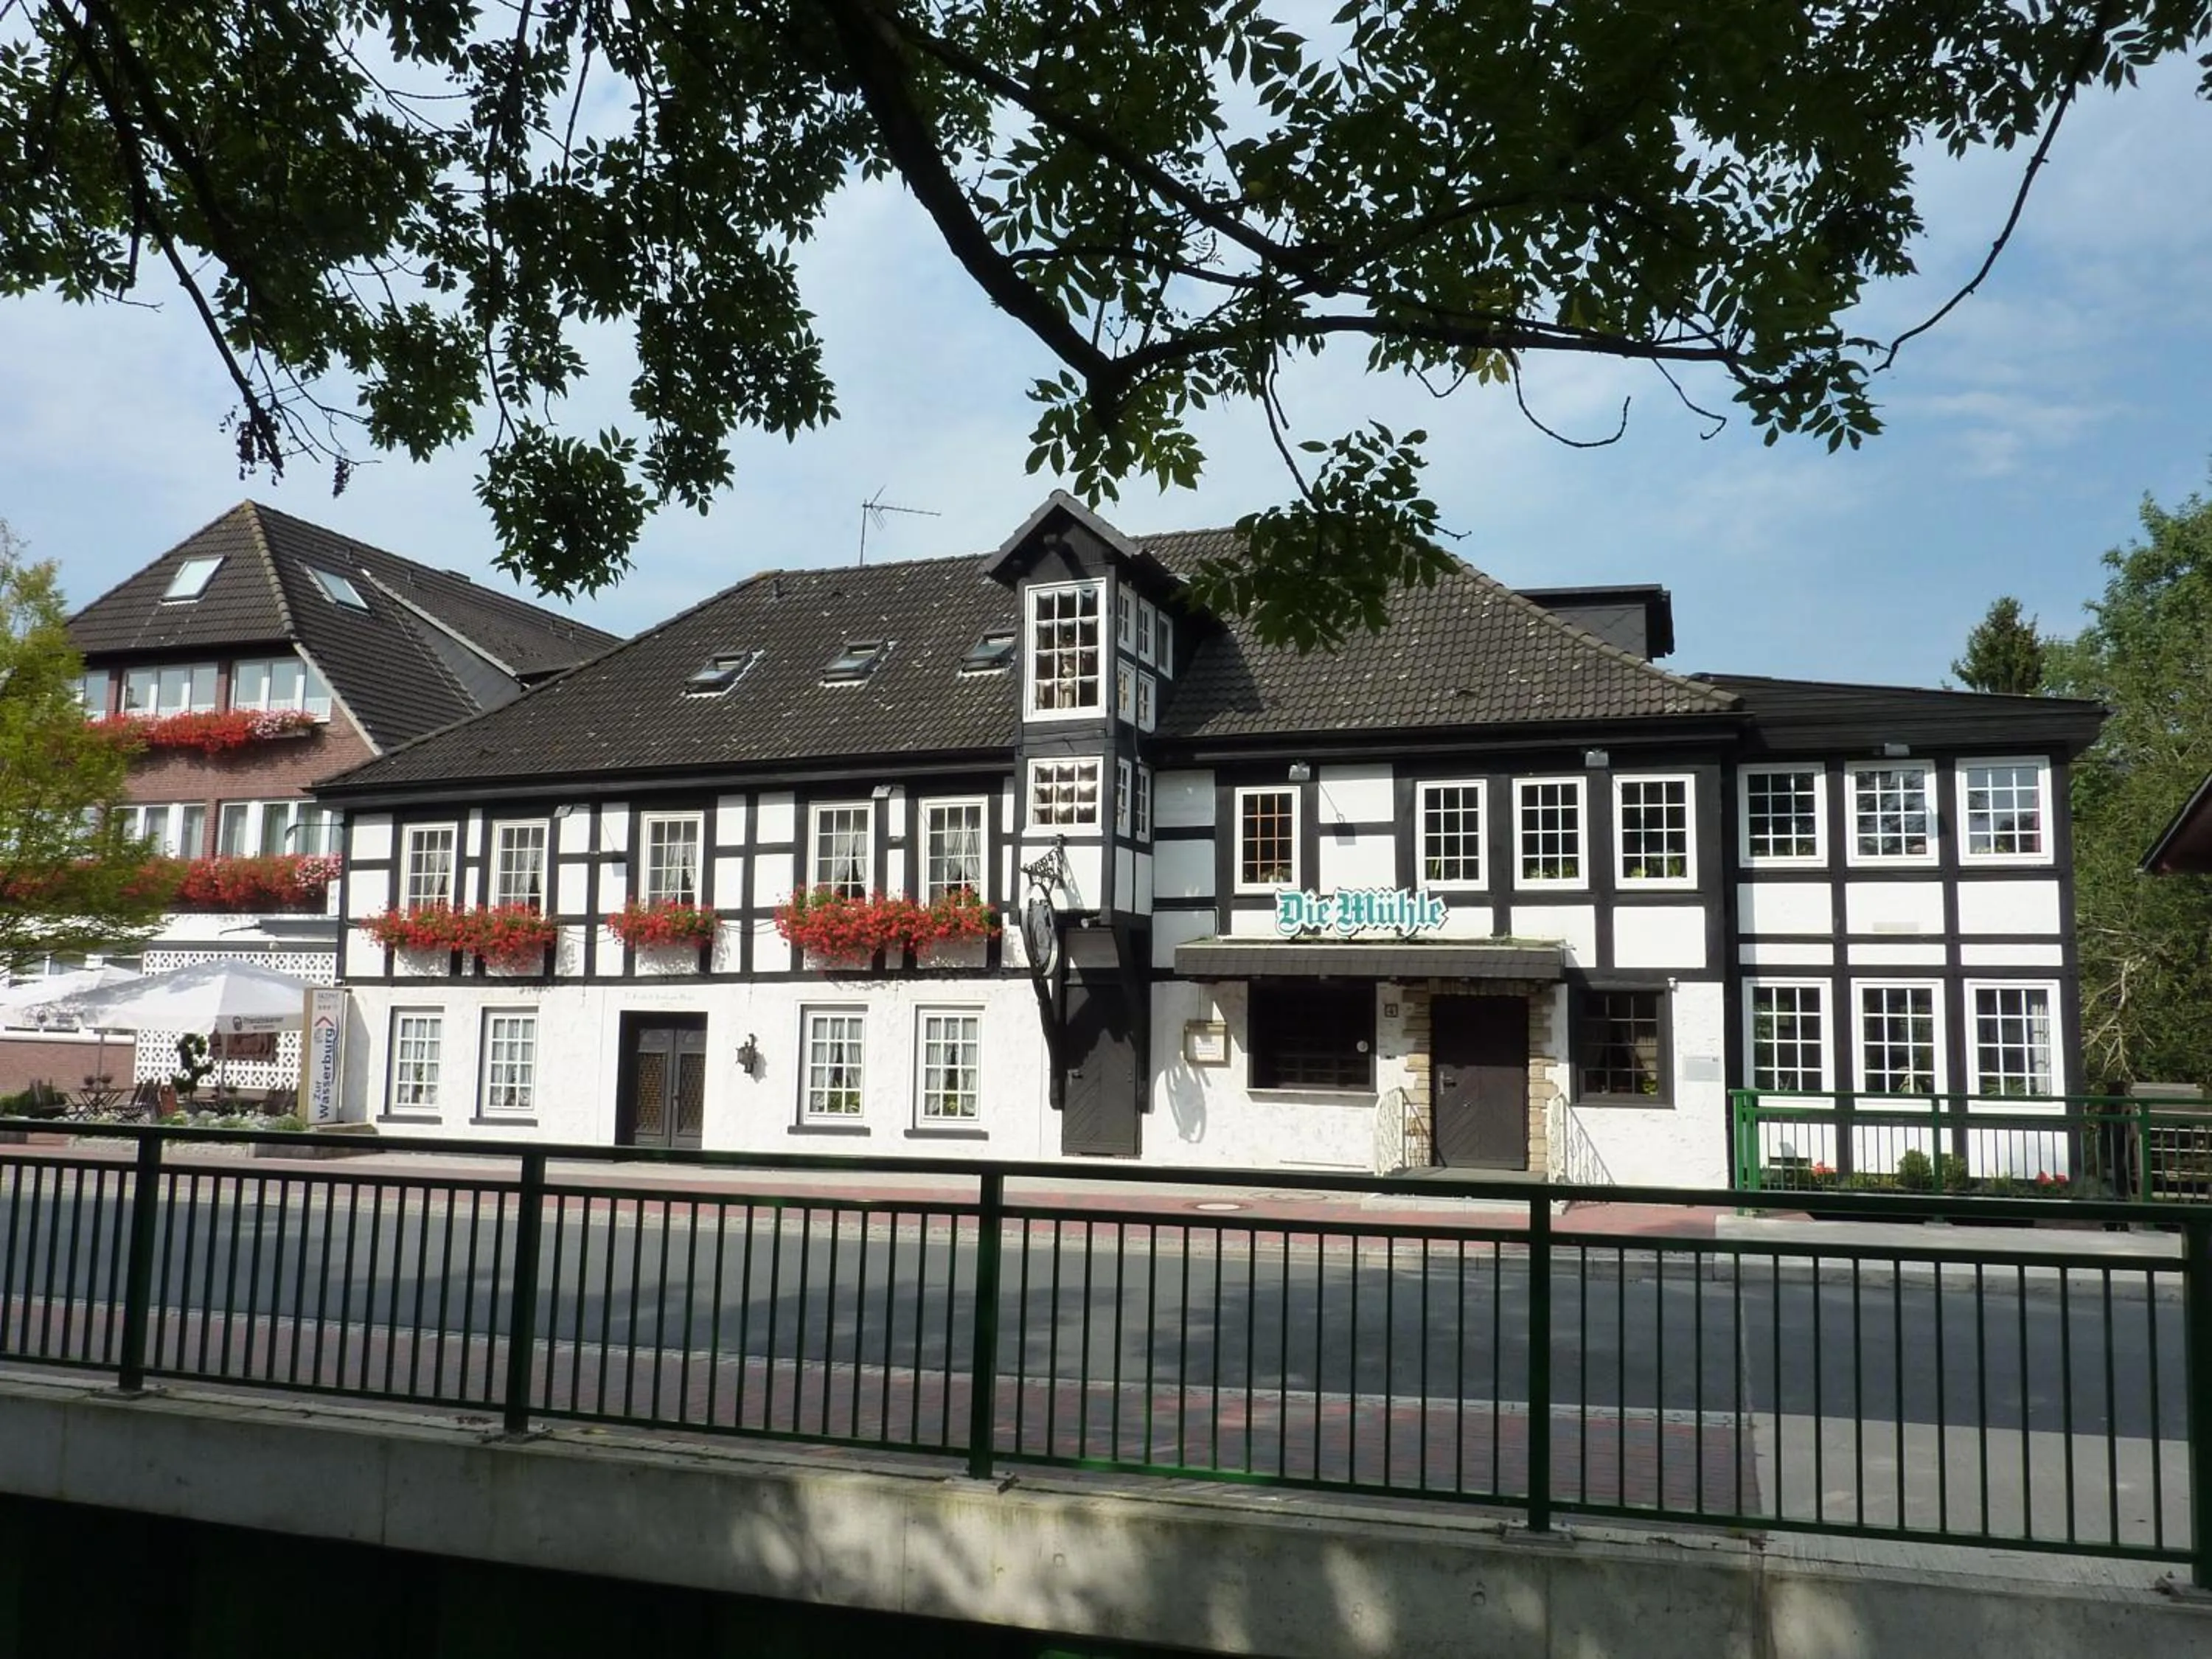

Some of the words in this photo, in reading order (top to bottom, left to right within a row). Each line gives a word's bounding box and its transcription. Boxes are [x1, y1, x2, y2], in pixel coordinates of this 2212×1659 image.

[1278, 890, 1329, 928] Die
[1335, 890, 1444, 932] Mühle
[313, 1081, 322, 1100] Zur
[319, 1028, 335, 1119] Wasserburg
